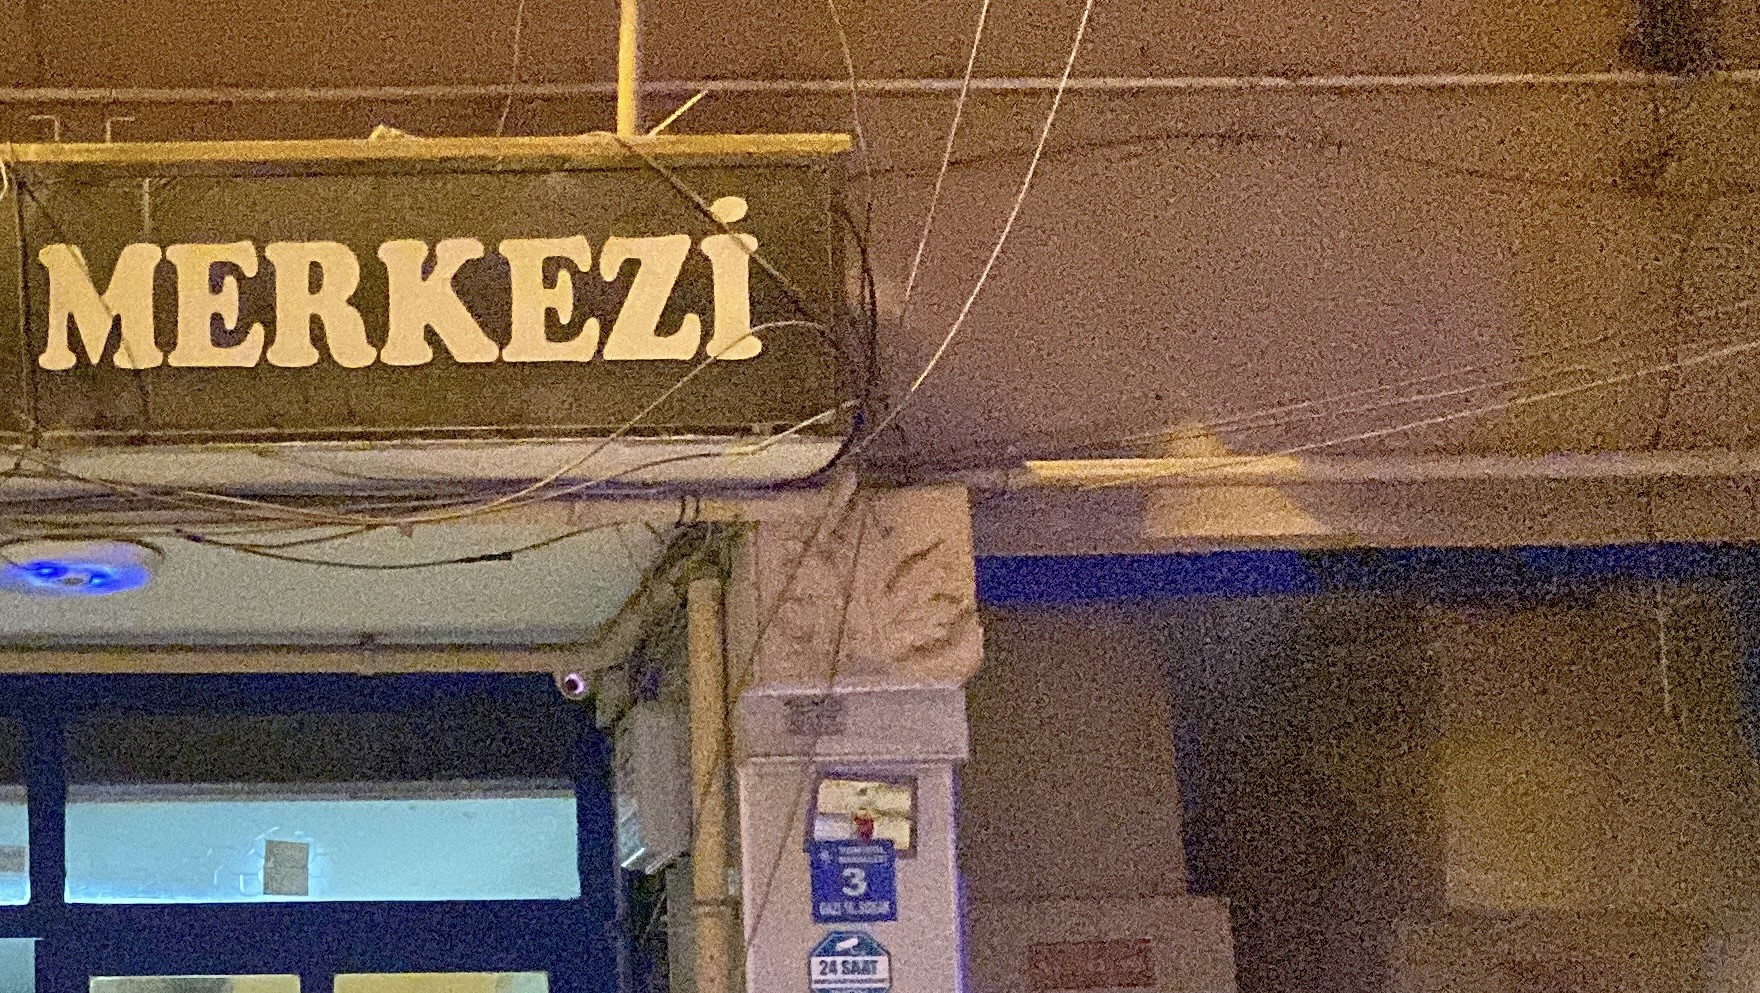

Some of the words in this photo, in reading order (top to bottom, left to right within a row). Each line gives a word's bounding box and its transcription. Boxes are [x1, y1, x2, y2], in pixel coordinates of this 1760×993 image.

[38, 196, 763, 371] MERKEZİ
[842, 868, 867, 897] 3
[819, 959, 838, 976] 24
[841, 959, 879, 976] SAAT
